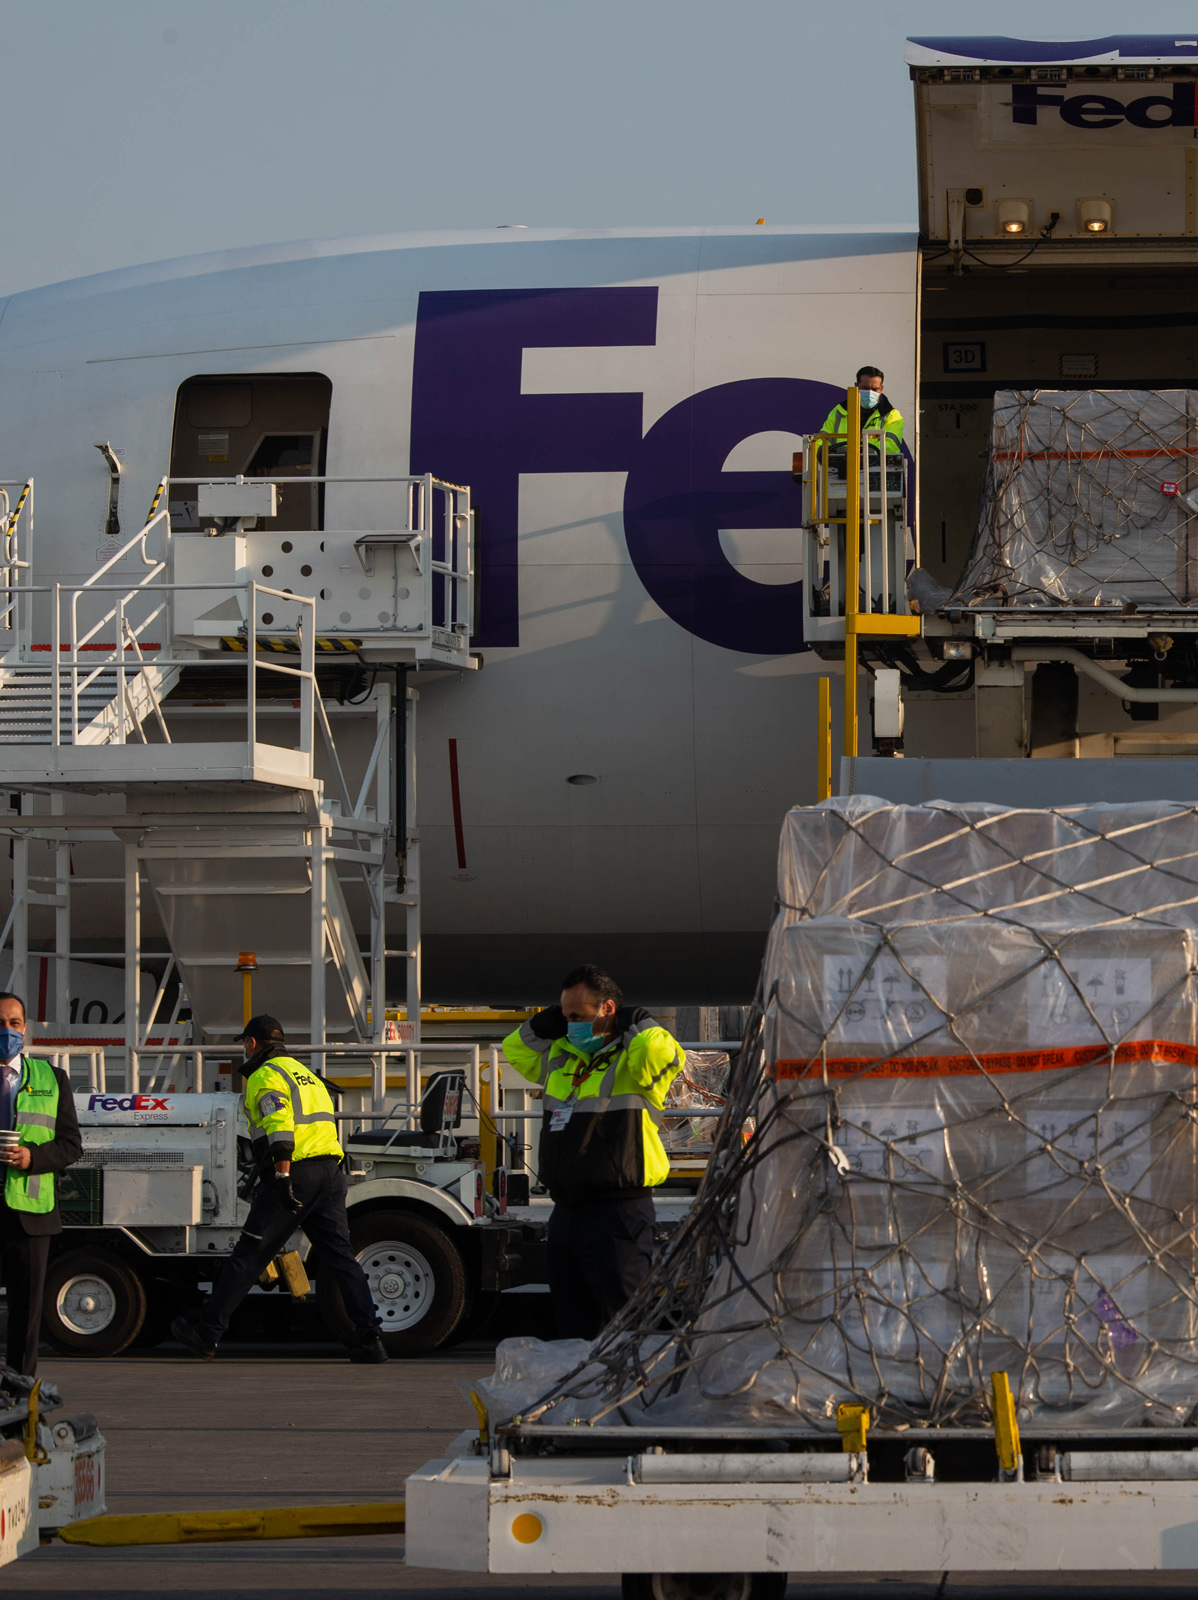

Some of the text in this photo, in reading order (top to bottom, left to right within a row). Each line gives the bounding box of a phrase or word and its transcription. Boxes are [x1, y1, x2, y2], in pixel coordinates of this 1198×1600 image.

[953, 349, 976, 364] 3D
[938, 403, 978, 412] STA 500
[986, 1056, 1012, 1069] BYPASS
[1042, 1053, 1064, 1066] BREAK
[88, 1094, 171, 1111] FedEx
[133, 1111, 169, 1123] Express
